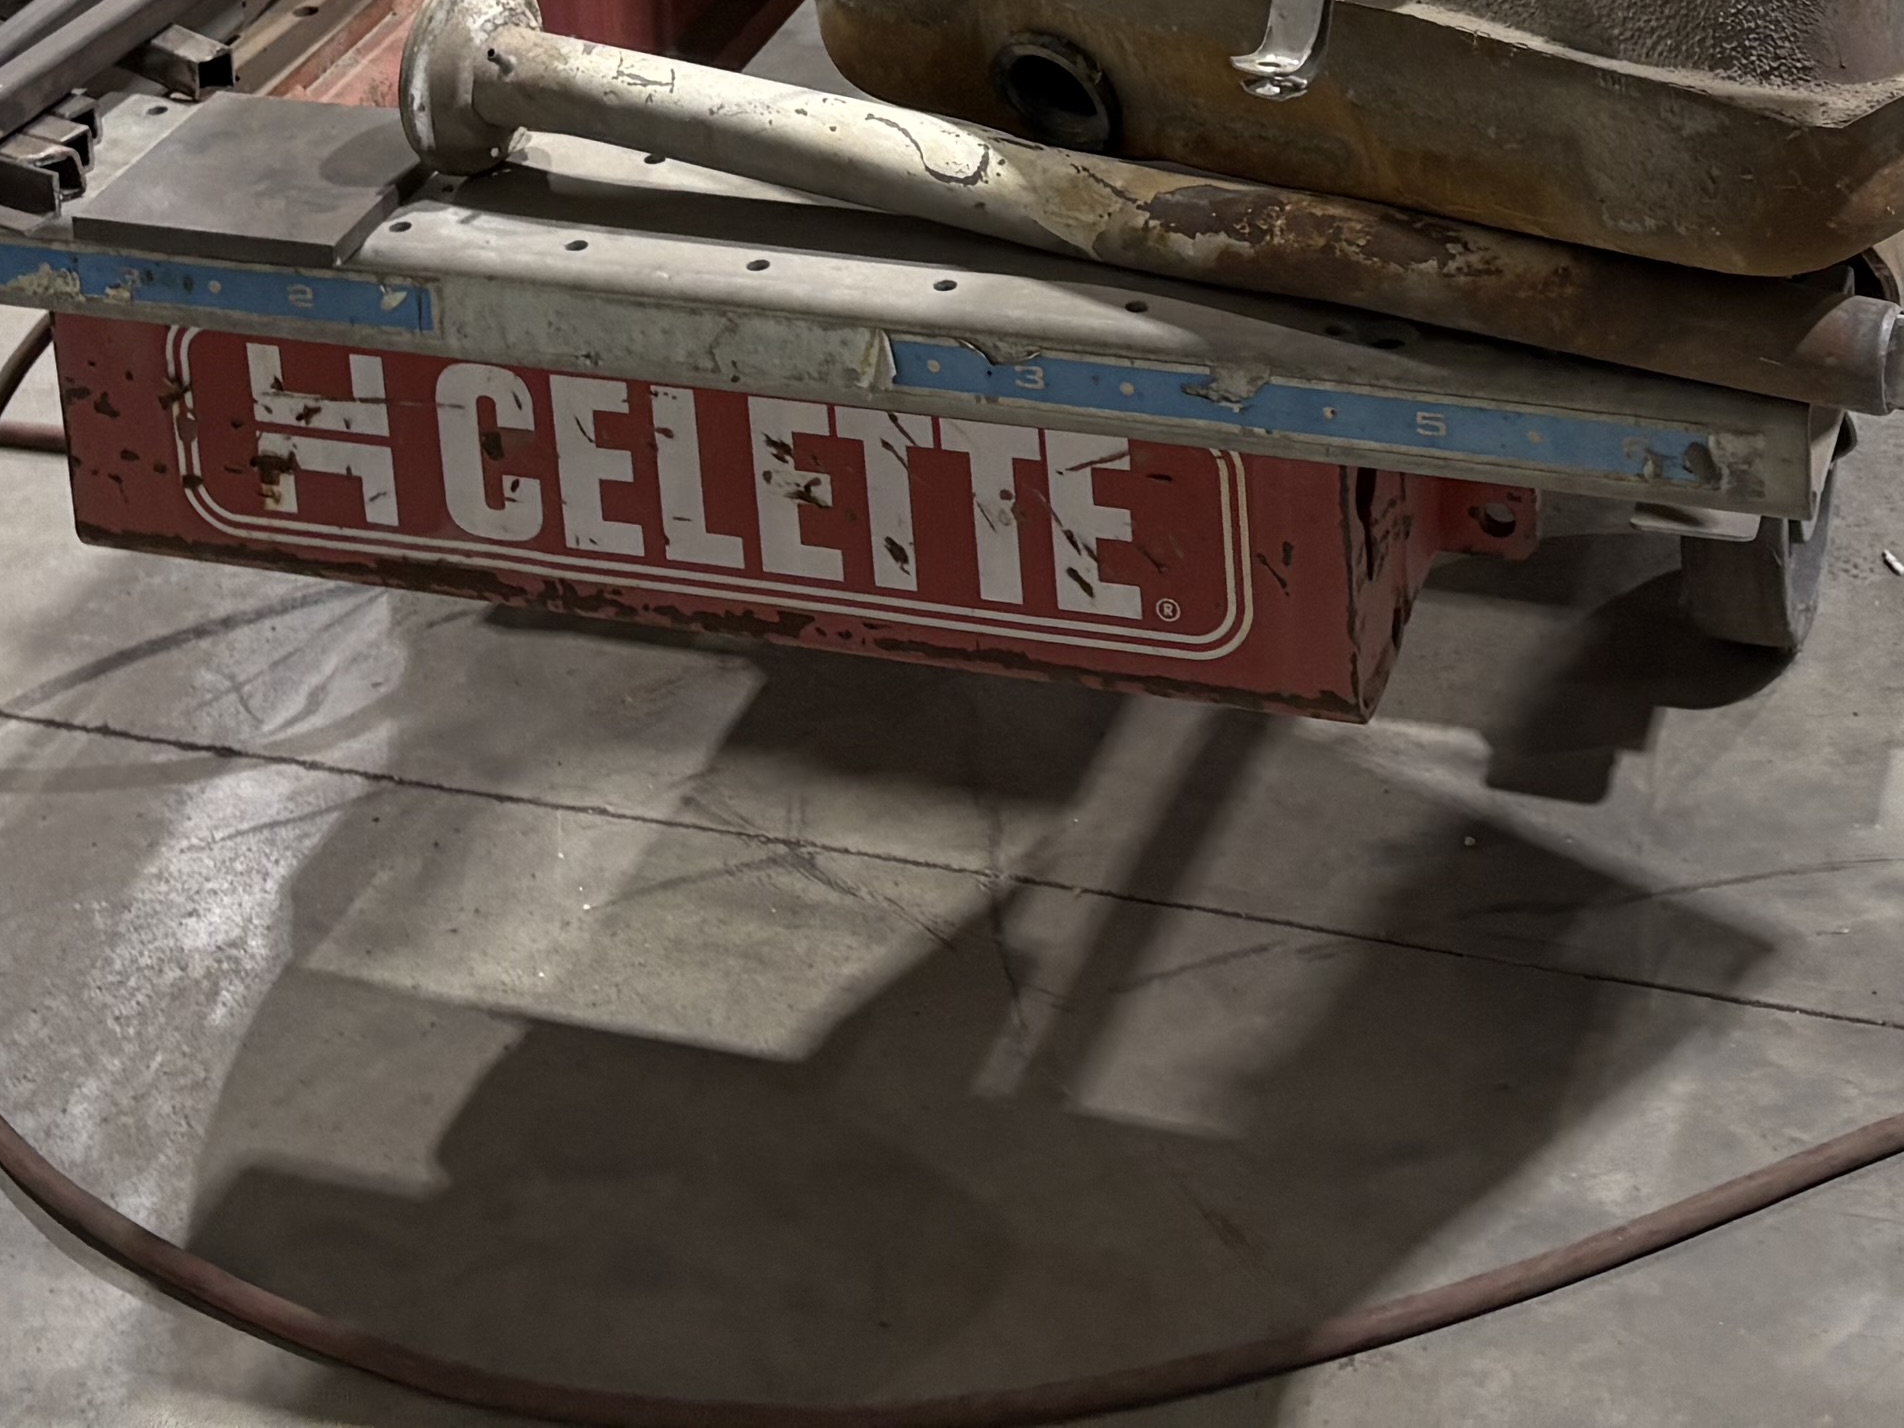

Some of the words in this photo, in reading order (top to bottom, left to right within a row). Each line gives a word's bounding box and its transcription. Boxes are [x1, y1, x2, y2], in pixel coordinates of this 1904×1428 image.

[287, 283, 314, 309] 2
[1014, 365, 1046, 391] 3
[1416, 411, 1448, 437] 5
[436, 362, 1143, 620] CELETTE
